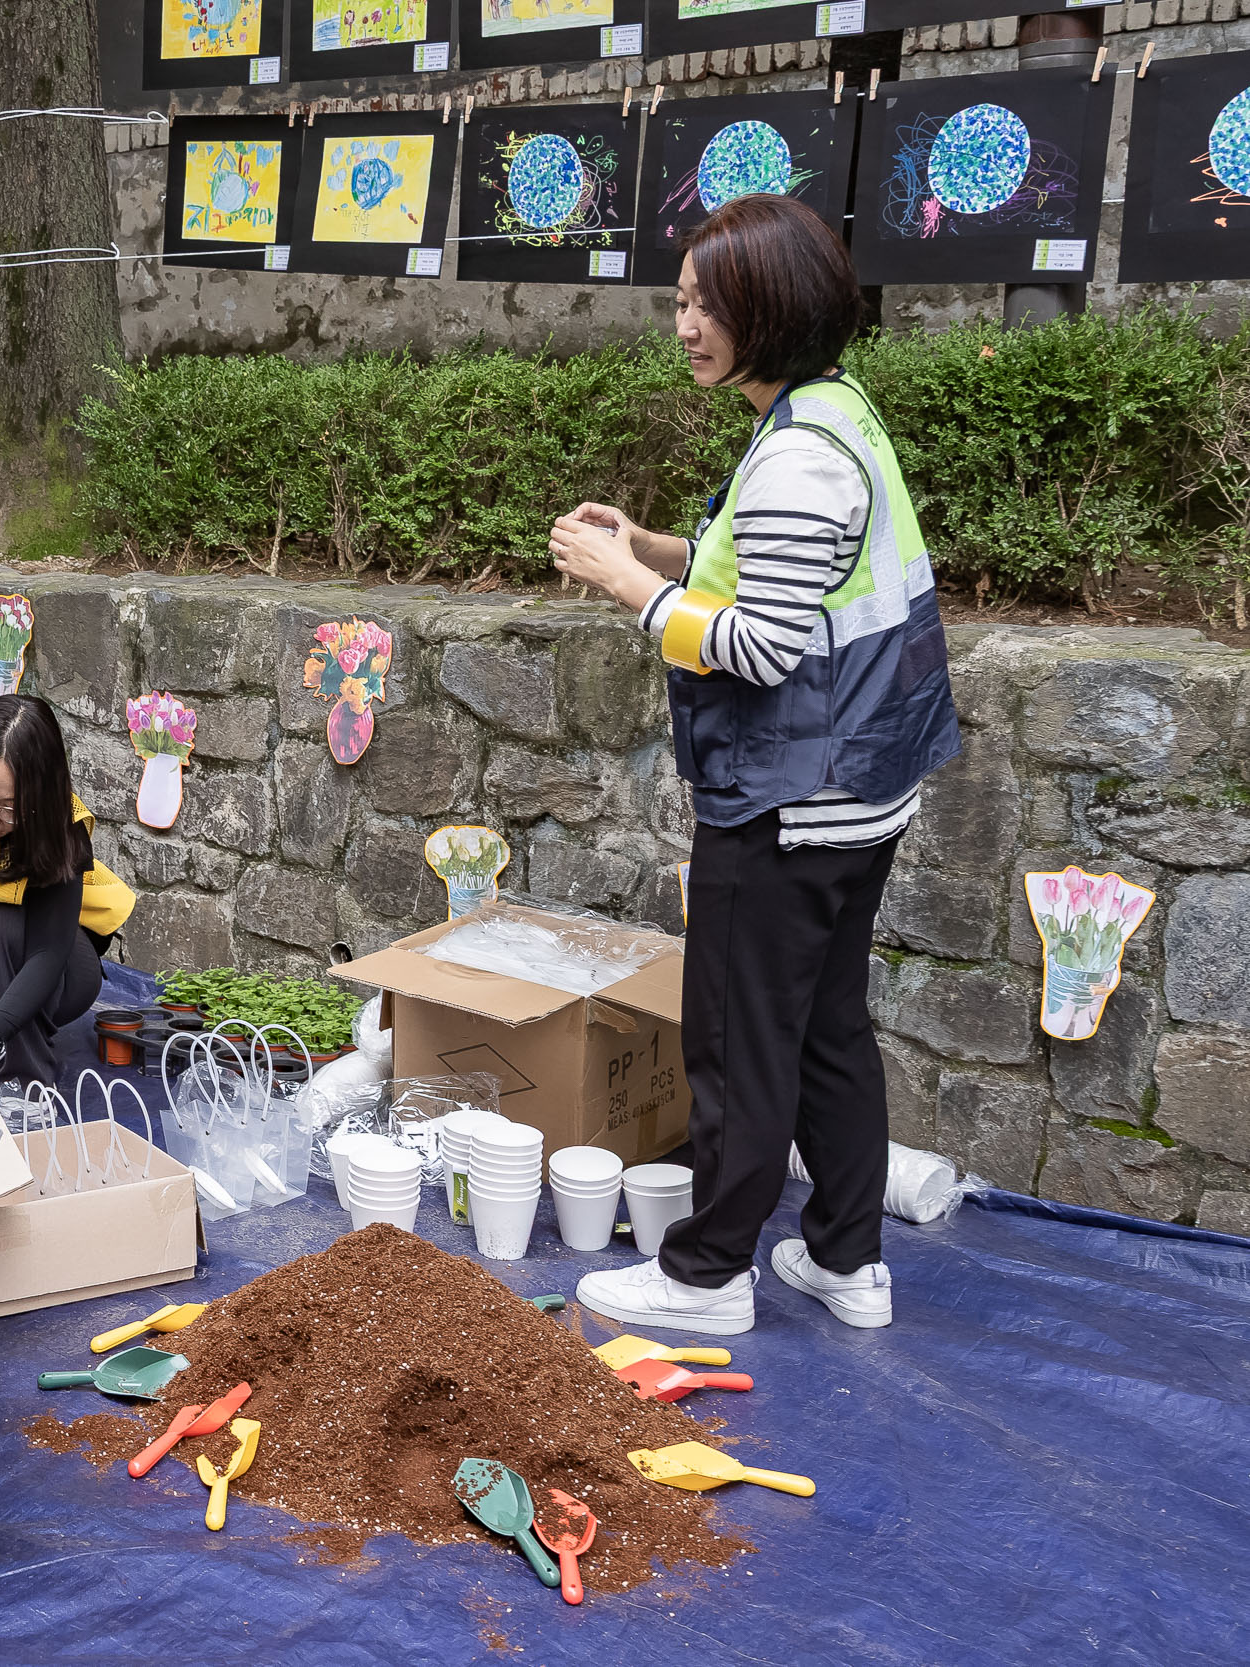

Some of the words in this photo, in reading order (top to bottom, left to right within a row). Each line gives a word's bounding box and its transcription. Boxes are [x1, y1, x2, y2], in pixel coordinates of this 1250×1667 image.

[608, 1089, 628, 1115] 250
[650, 1067, 674, 1094] PCS
[608, 1110, 631, 1132] MEAS:
